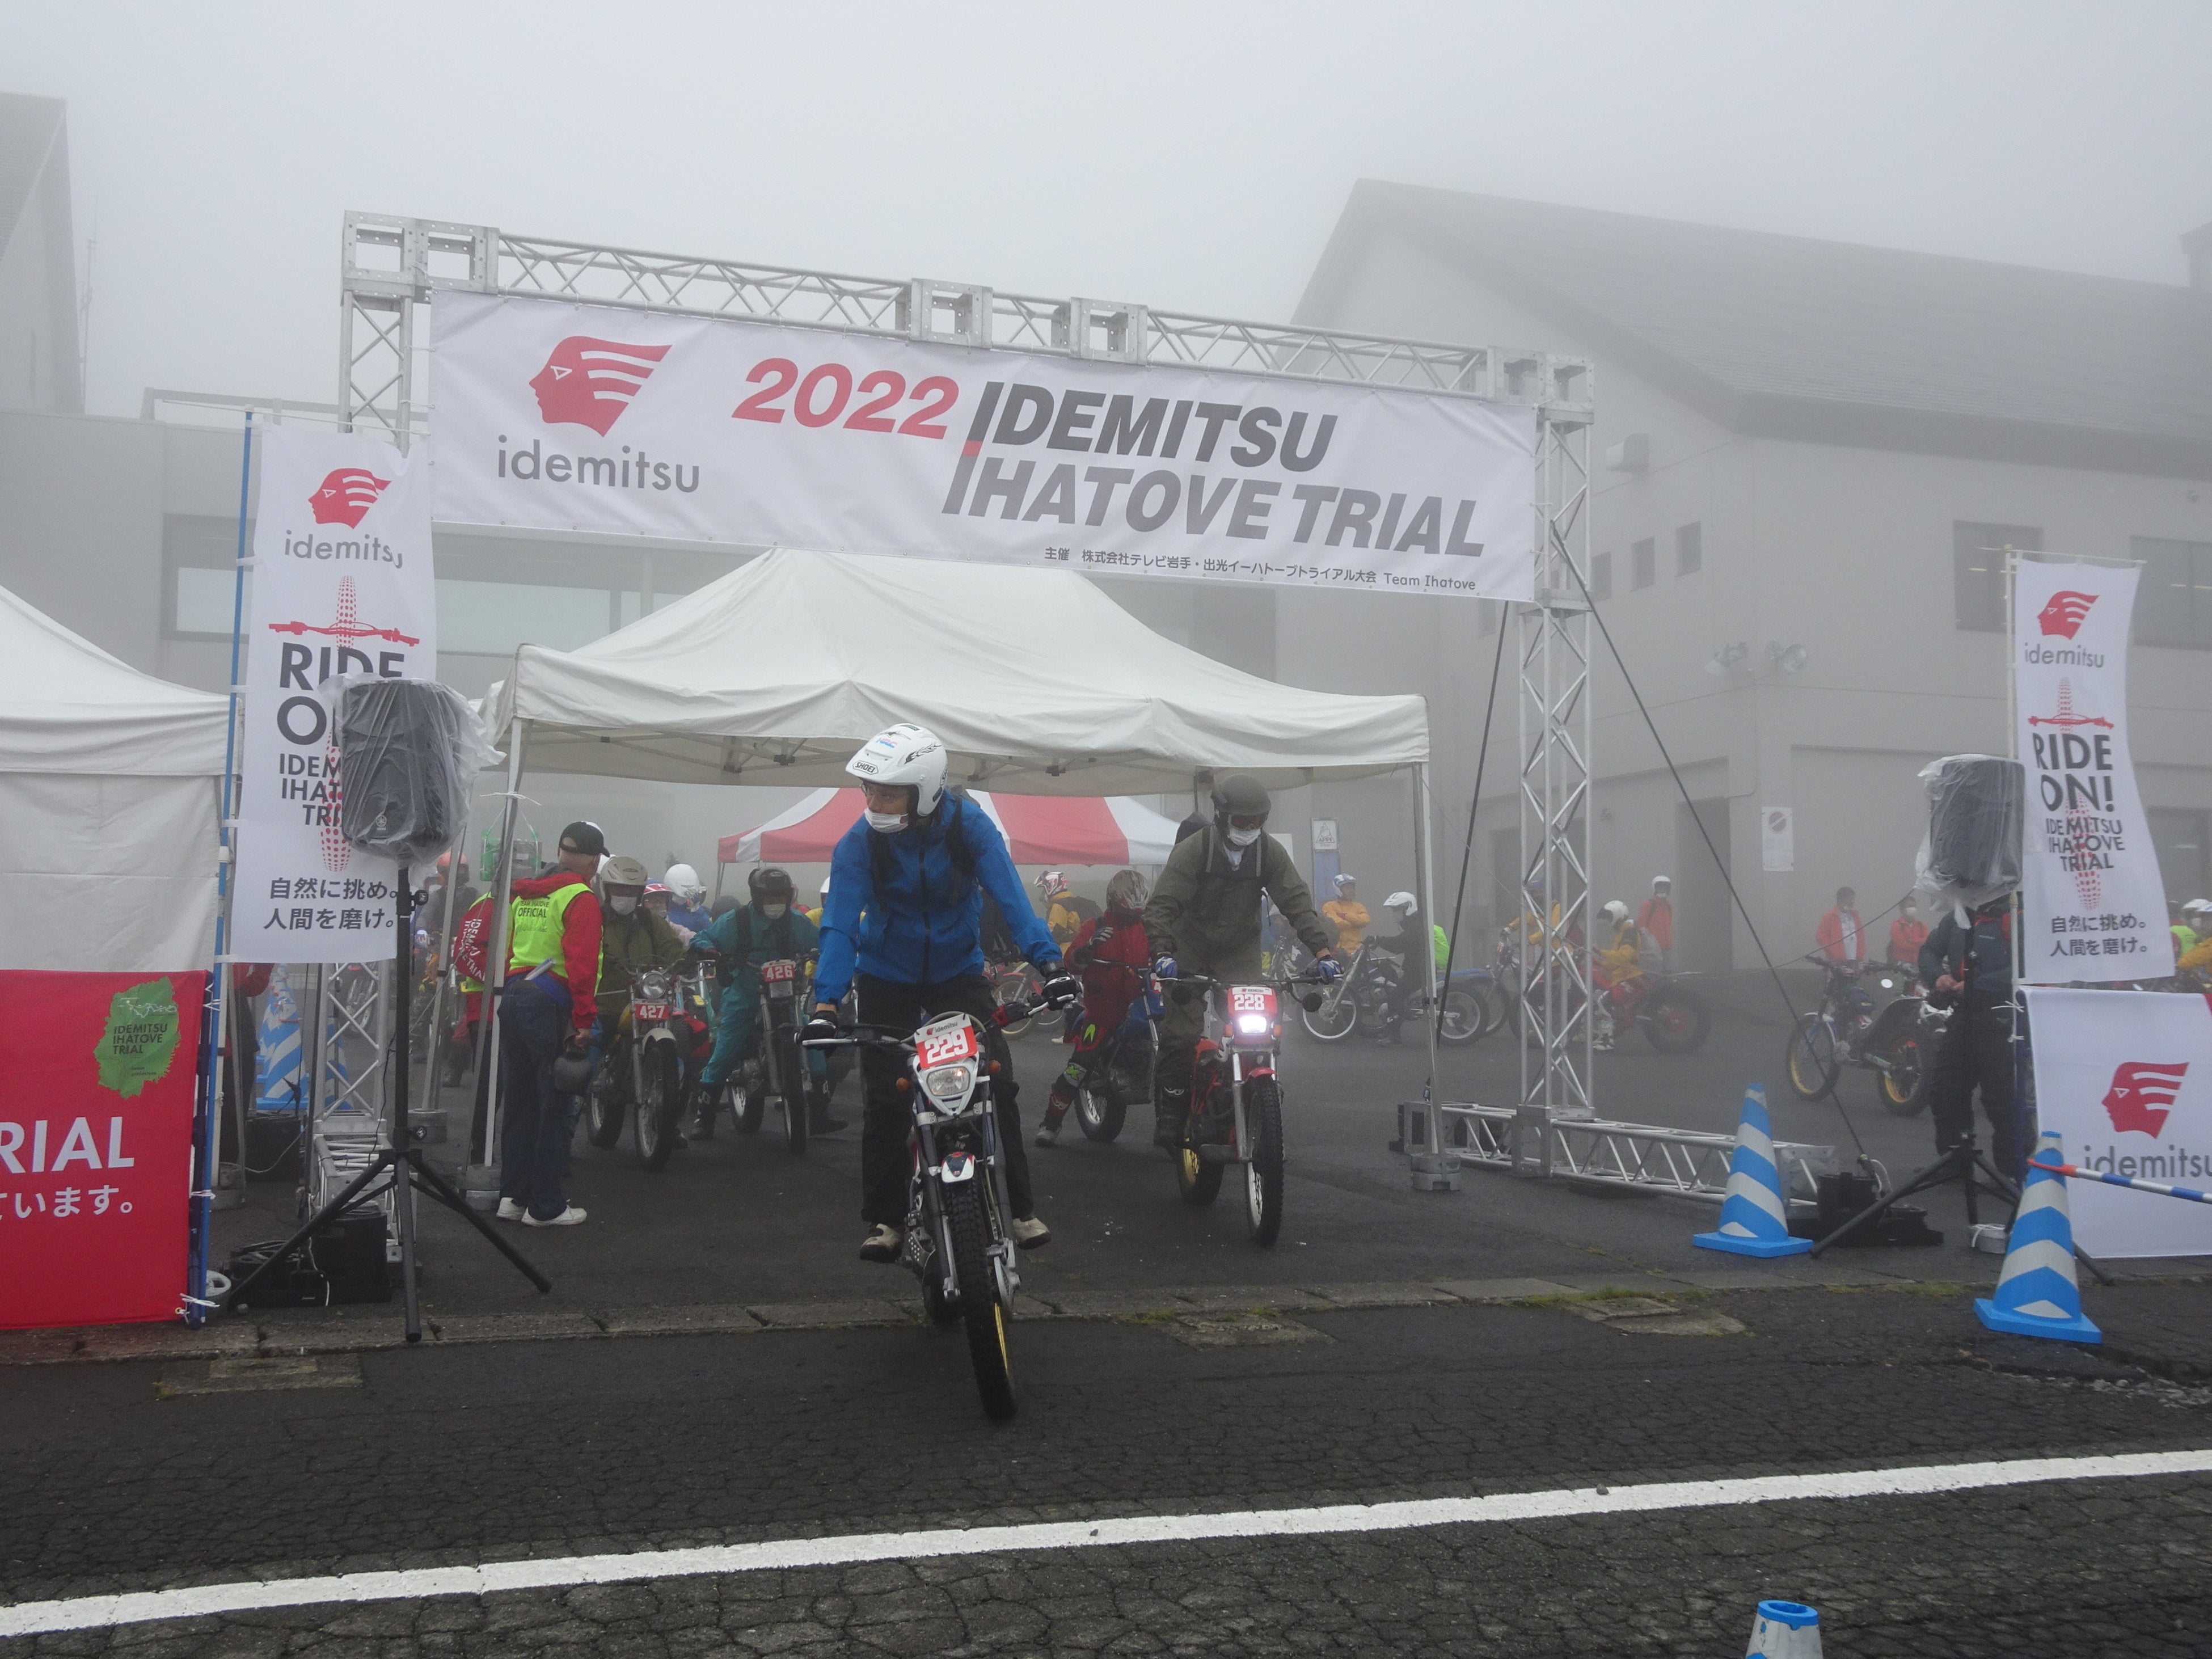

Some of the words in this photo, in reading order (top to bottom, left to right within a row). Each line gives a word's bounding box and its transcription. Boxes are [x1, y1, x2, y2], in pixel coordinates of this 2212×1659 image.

[731, 358, 959, 440] 2022
[966, 381, 1339, 472] IDEMITSU
[497, 434, 699, 493] idemitsu
[942, 454, 1282, 540] IHATOVE
[1292, 484, 1485, 558] TRIAL
[1044, 547, 1070, 561] 主催
[1383, 572, 1420, 586] Team
[1424, 575, 1475, 590] Ihatove
[2024, 642, 2104, 668] idemitsu
[2032, 732, 2113, 770] RIDE
[279, 753, 341, 778] IDEM
[855, 762, 876, 773] SHOEI
[2041, 774, 2114, 812] ON!
[302, 804, 341, 827] TRI
[2046, 817, 2123, 835] IDEMITSU
[2049, 835, 2126, 854] IHATOVE
[2060, 852, 2114, 872] TRIAL
[270, 877, 398, 900] 自然に挑め。
[263, 907, 395, 931] 人間を磨け。
[518, 907, 547, 918] OFFICIAL
[2051, 913, 2146, 934] 自然に挑め。
[2050, 937, 2147, 956] 人間を磨け。
[767, 965, 793, 980] 426
[640, 1005, 665, 1018] 427
[1234, 994, 1265, 1011] 228
[114, 1023, 168, 1035] IDEMITSU
[935, 1022, 958, 1032] idemitsu
[113, 1034, 163, 1044] IHATOVE
[113, 1044, 143, 1054] TRIAL
[925, 1028, 969, 1064] 229
[0, 1116, 135, 1174] RIAL
[0, 1184, 133, 1219] います。
